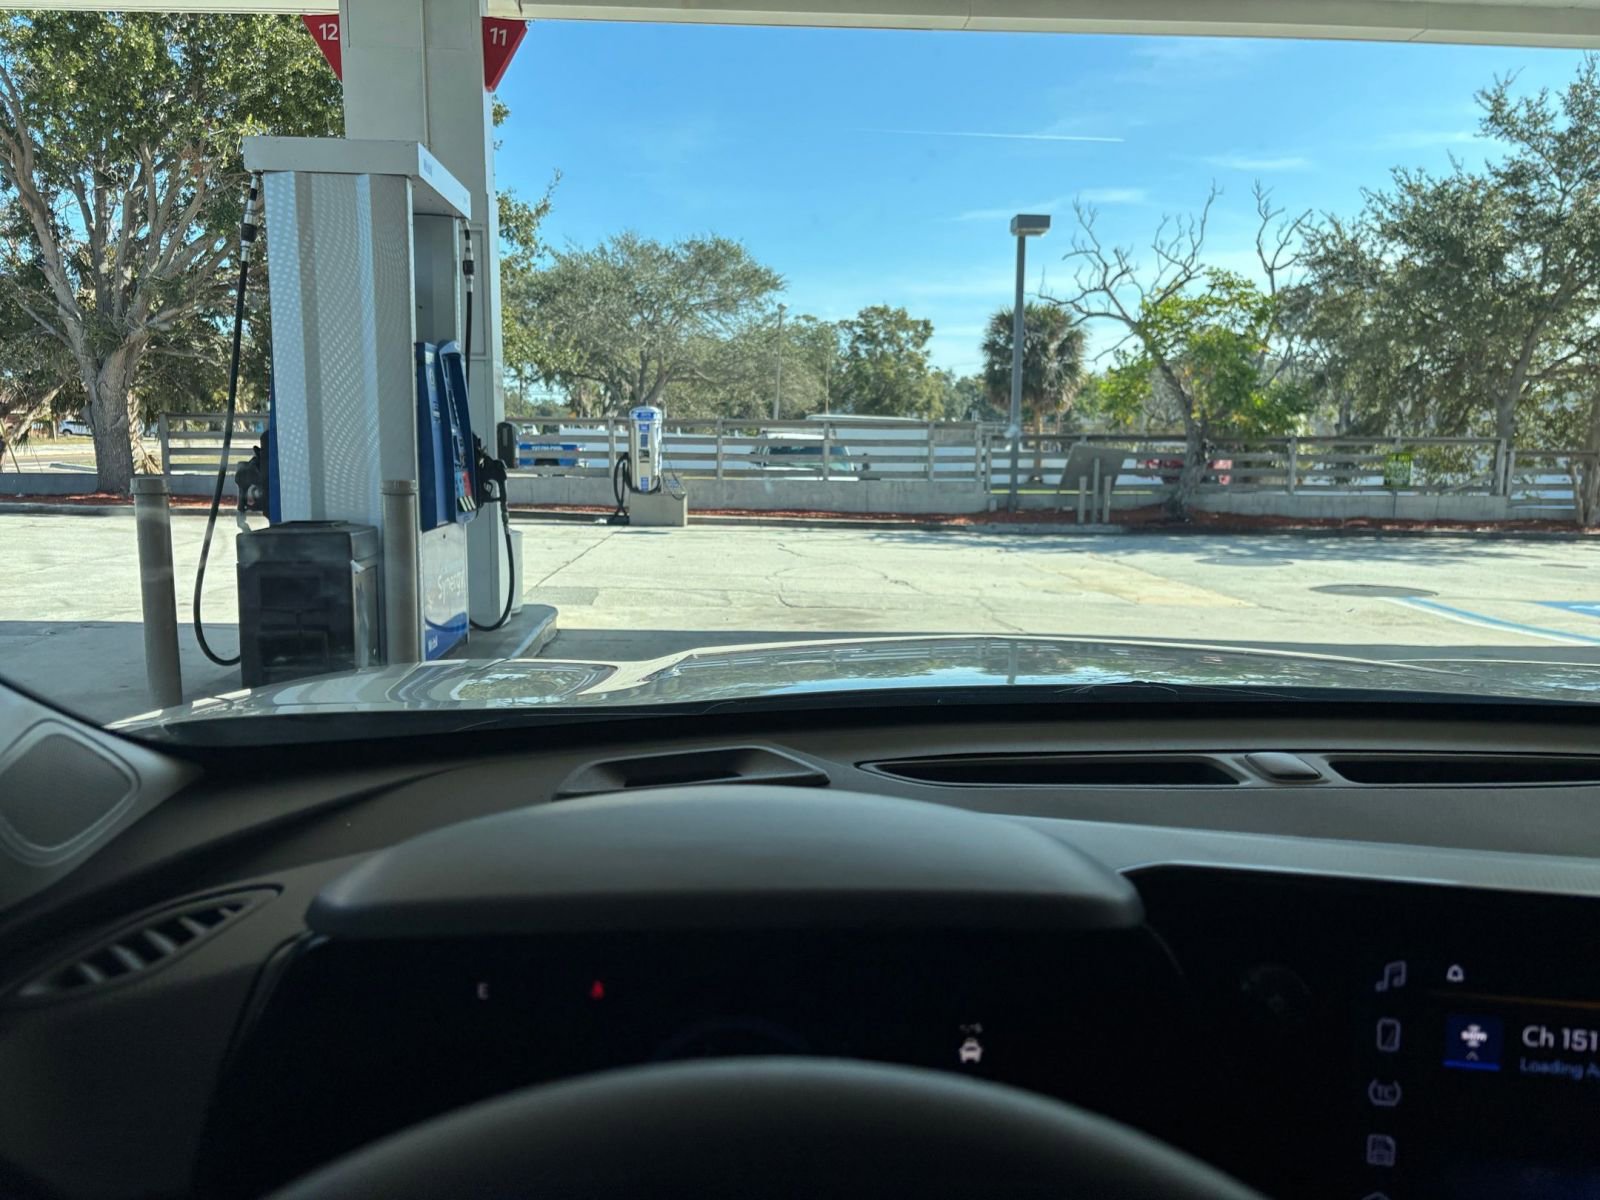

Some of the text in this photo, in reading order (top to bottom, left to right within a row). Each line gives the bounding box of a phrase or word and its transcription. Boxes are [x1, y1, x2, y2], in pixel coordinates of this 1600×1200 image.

[319, 23, 339, 41] 12
[489, 27, 507, 46] 11
[1521, 1025, 1598, 1053] Ch 151
[1519, 1056, 1584, 1081] Loading
